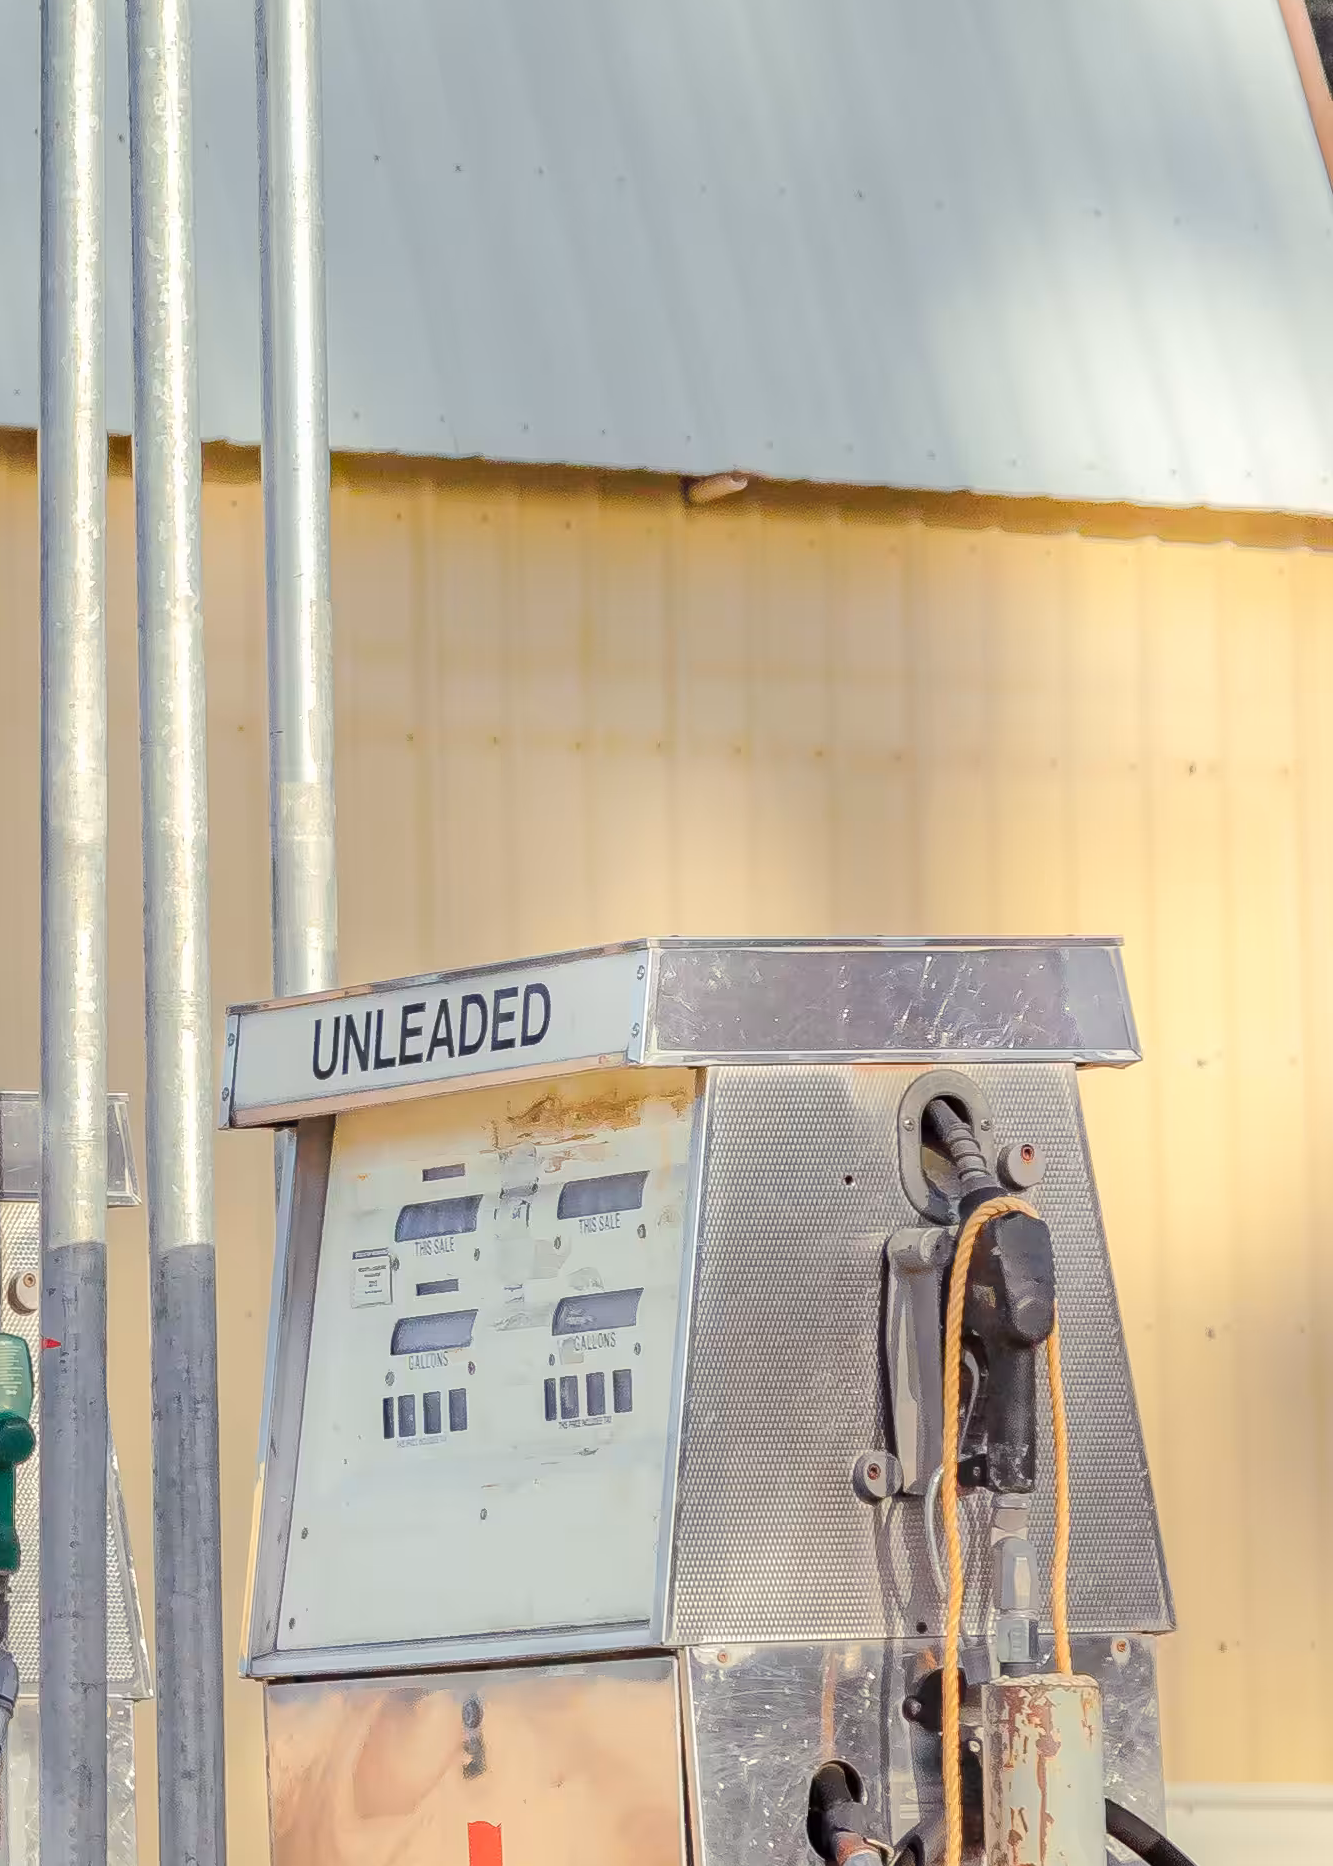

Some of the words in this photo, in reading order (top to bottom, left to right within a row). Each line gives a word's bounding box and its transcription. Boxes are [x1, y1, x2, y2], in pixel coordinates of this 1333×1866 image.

[312, 982, 551, 1081] UNLEADED
[579, 1217, 598, 1235] THIS
[598, 1213, 621, 1231] SALE
[414, 1241, 433, 1257] THIS
[434, 1237, 455, 1254] SALE
[573, 1332, 617, 1352] GALLONS
[408, 1351, 449, 1371] GALLONS
